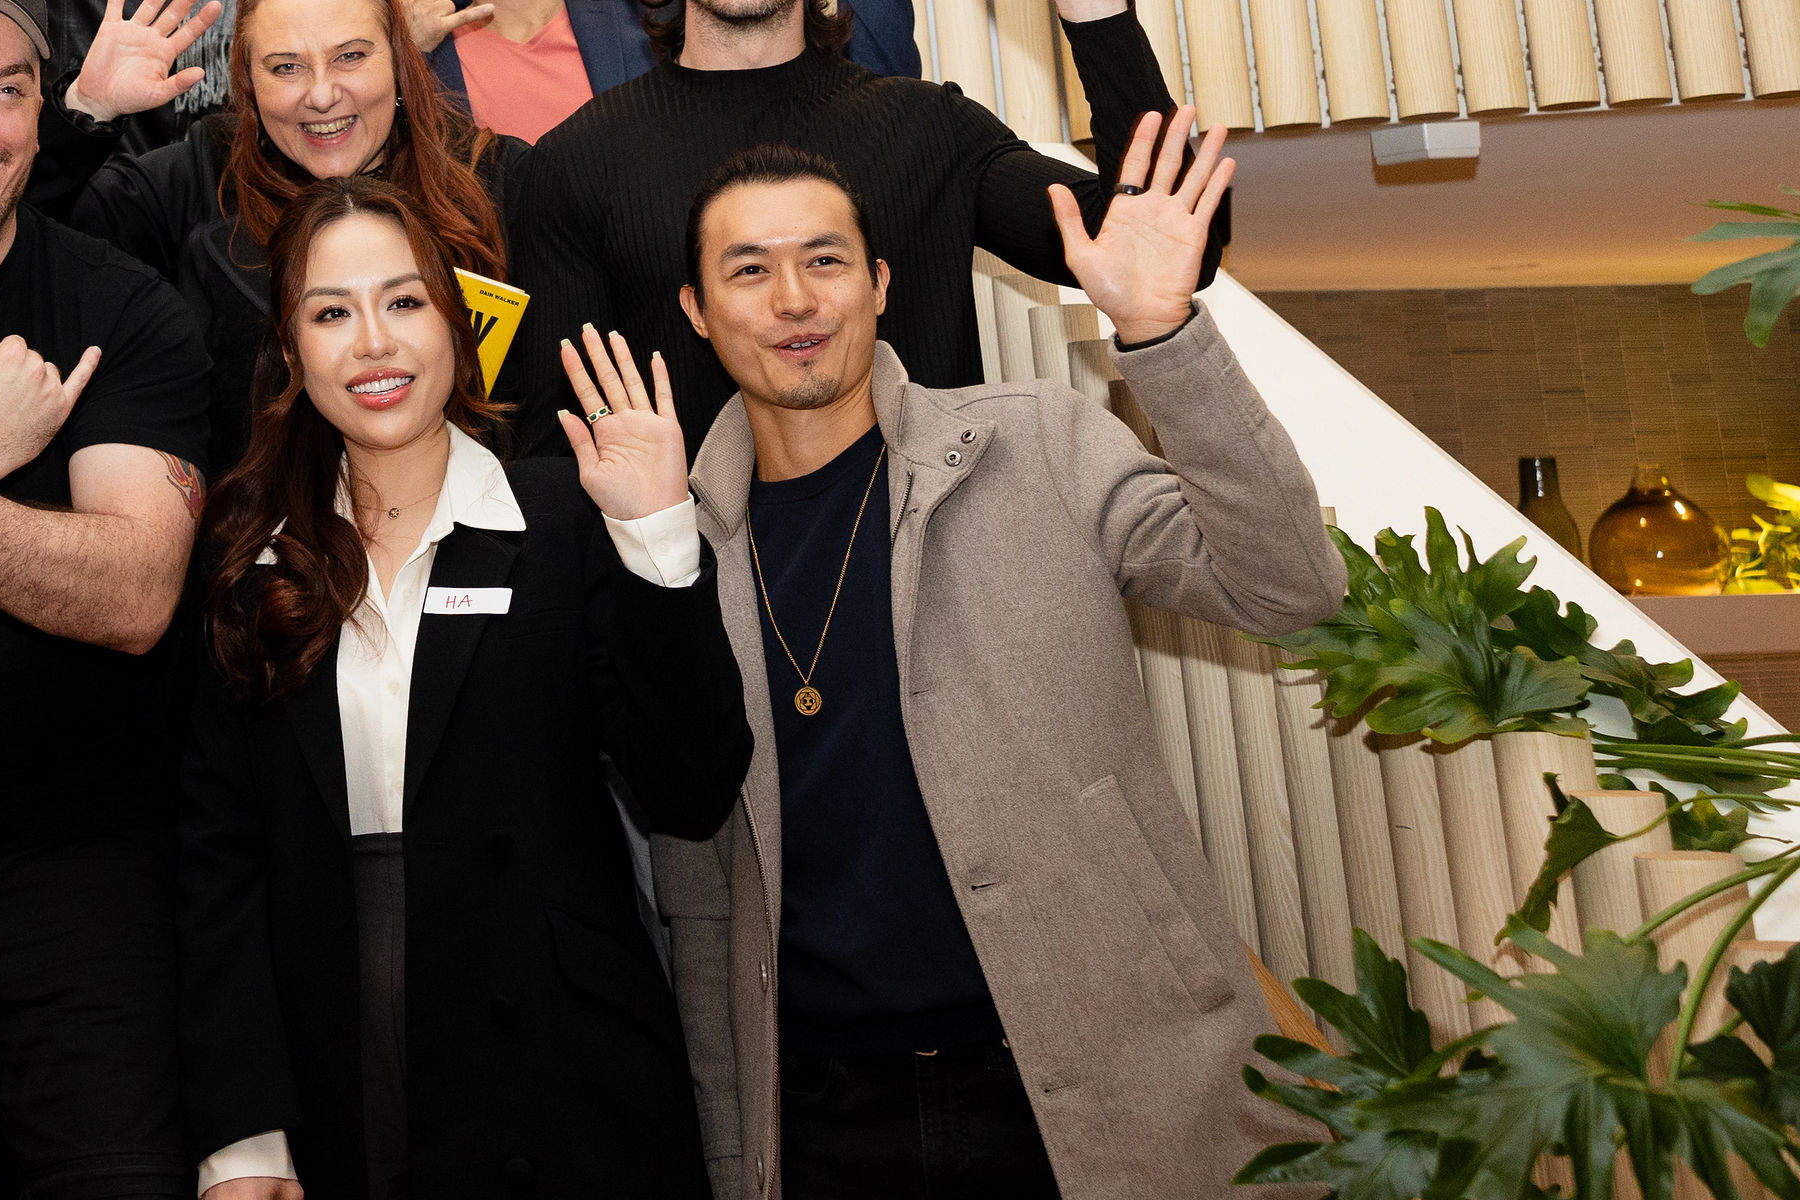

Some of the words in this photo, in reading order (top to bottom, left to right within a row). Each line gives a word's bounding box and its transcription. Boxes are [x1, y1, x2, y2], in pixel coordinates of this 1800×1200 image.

[479, 289, 493, 298] DAIN
[494, 294, 520, 307] WALKER
[446, 594, 472, 608] HA
